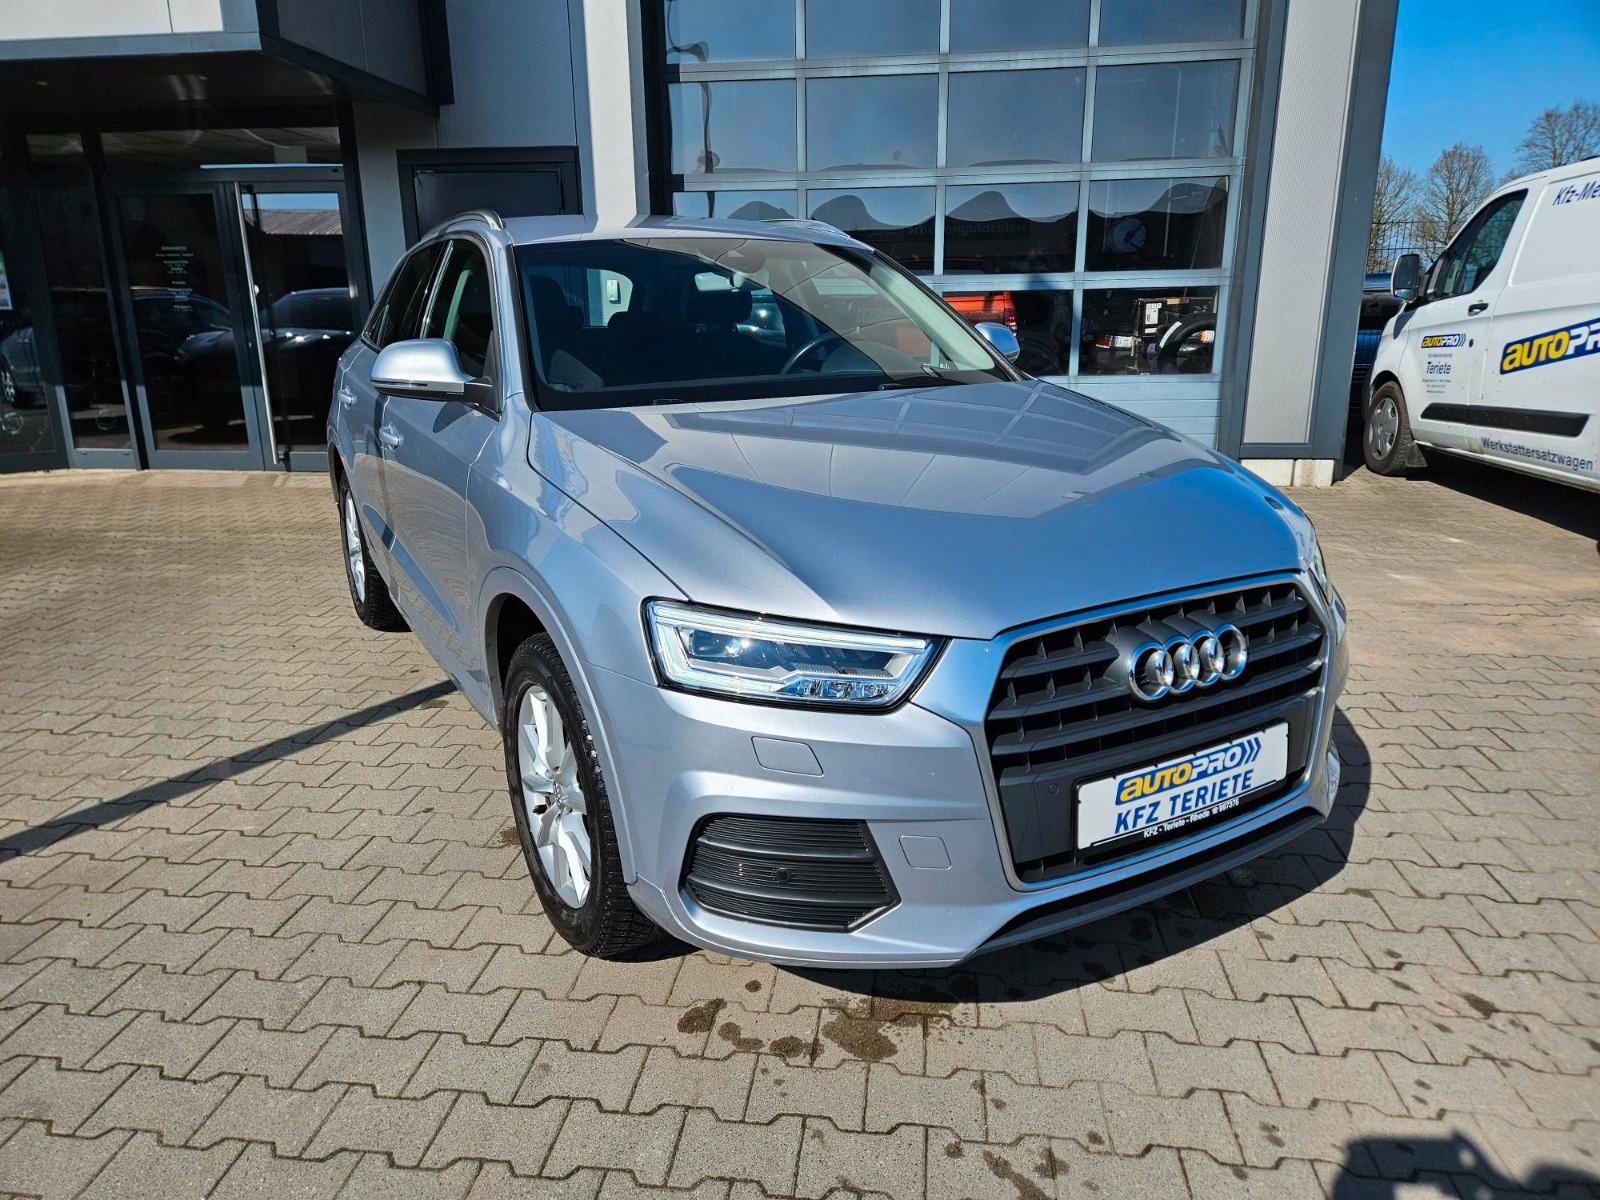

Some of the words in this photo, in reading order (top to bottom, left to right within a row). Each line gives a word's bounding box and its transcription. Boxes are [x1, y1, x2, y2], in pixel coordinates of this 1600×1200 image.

[1552, 180, 1600, 206] Kfz-Me
[1426, 361, 1452, 375] Teriete
[1481, 436, 1593, 471] Werkstattersatzwagen
[1115, 801, 1160, 834] KFZ
[1170, 769, 1254, 816] TERIETE
[1143, 826, 1159, 839] KFZ
[1163, 818, 1186, 832] Teriete
